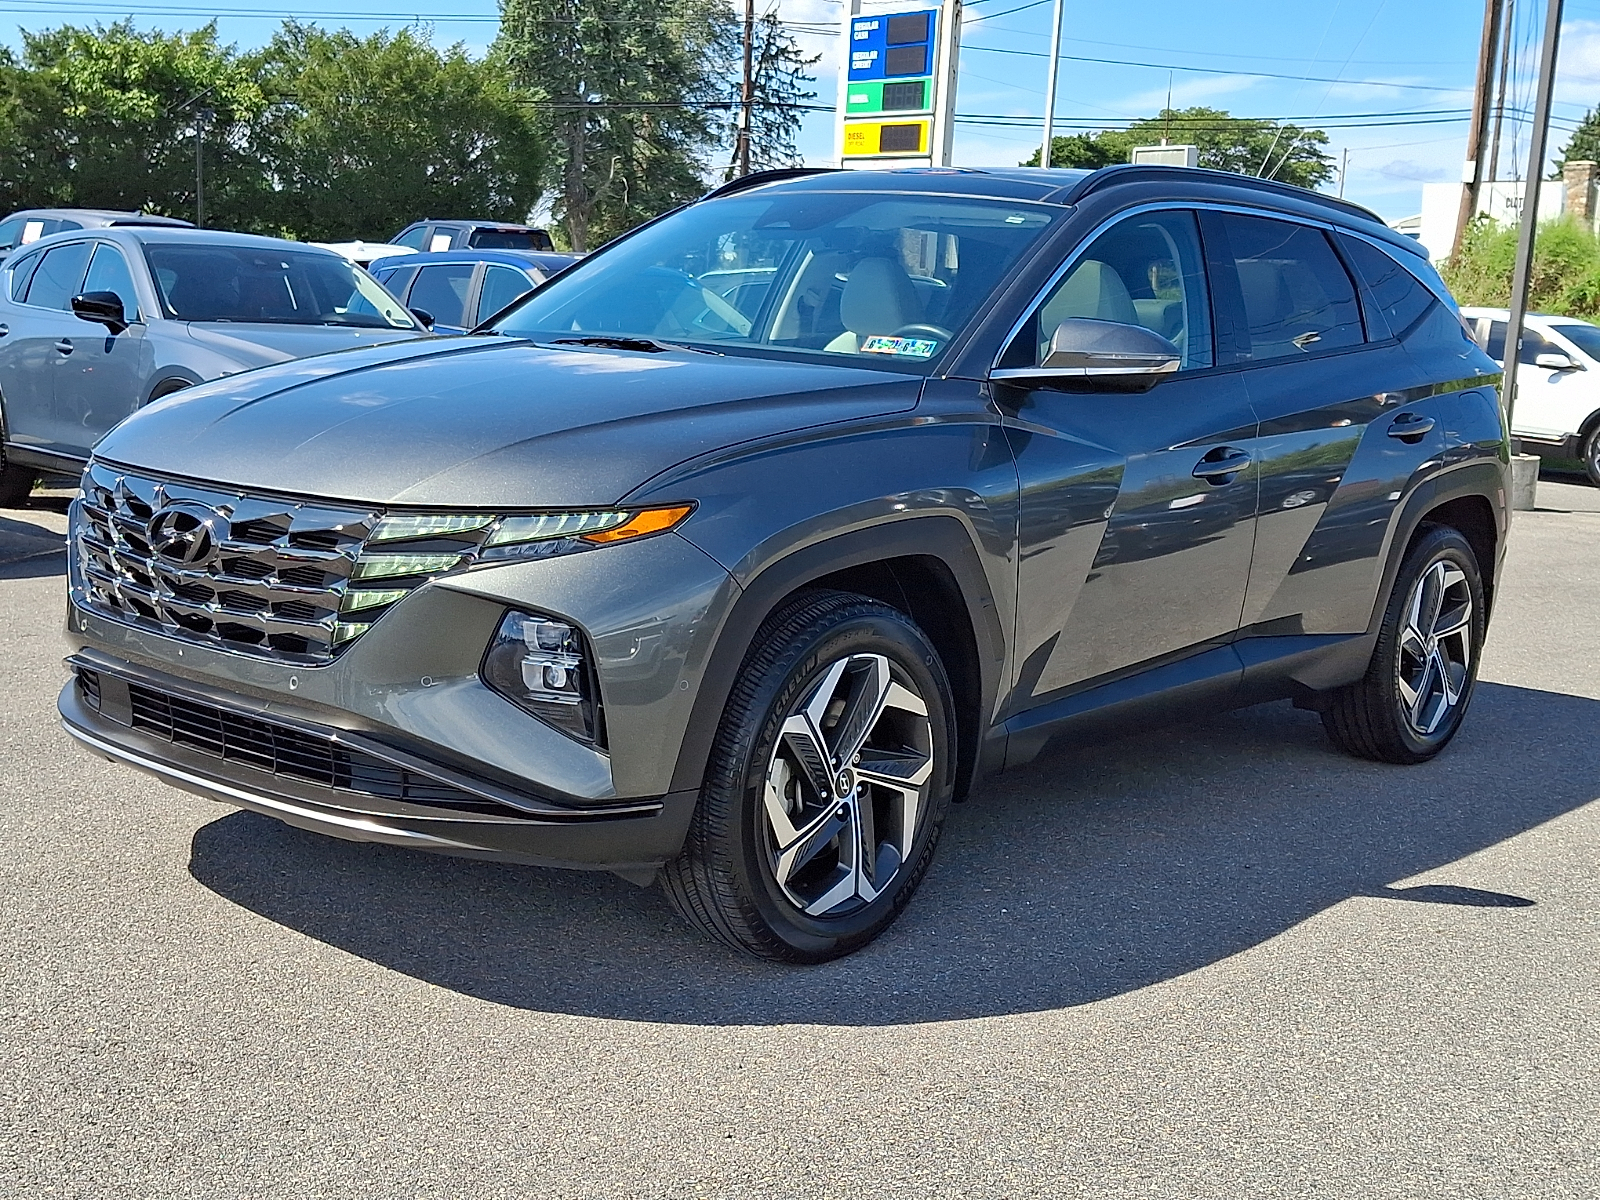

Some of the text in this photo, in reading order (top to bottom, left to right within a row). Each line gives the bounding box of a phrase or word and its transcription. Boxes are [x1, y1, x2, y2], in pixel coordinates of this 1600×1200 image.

[854, 21, 879, 31] REGULAR
[854, 31, 869, 40] CASH
[852, 51, 878, 60] REGULAR
[852, 60, 872, 69] CREDIT
[848, 132, 865, 140] DIESEL
[763, 653, 816, 742] MICHELIN
